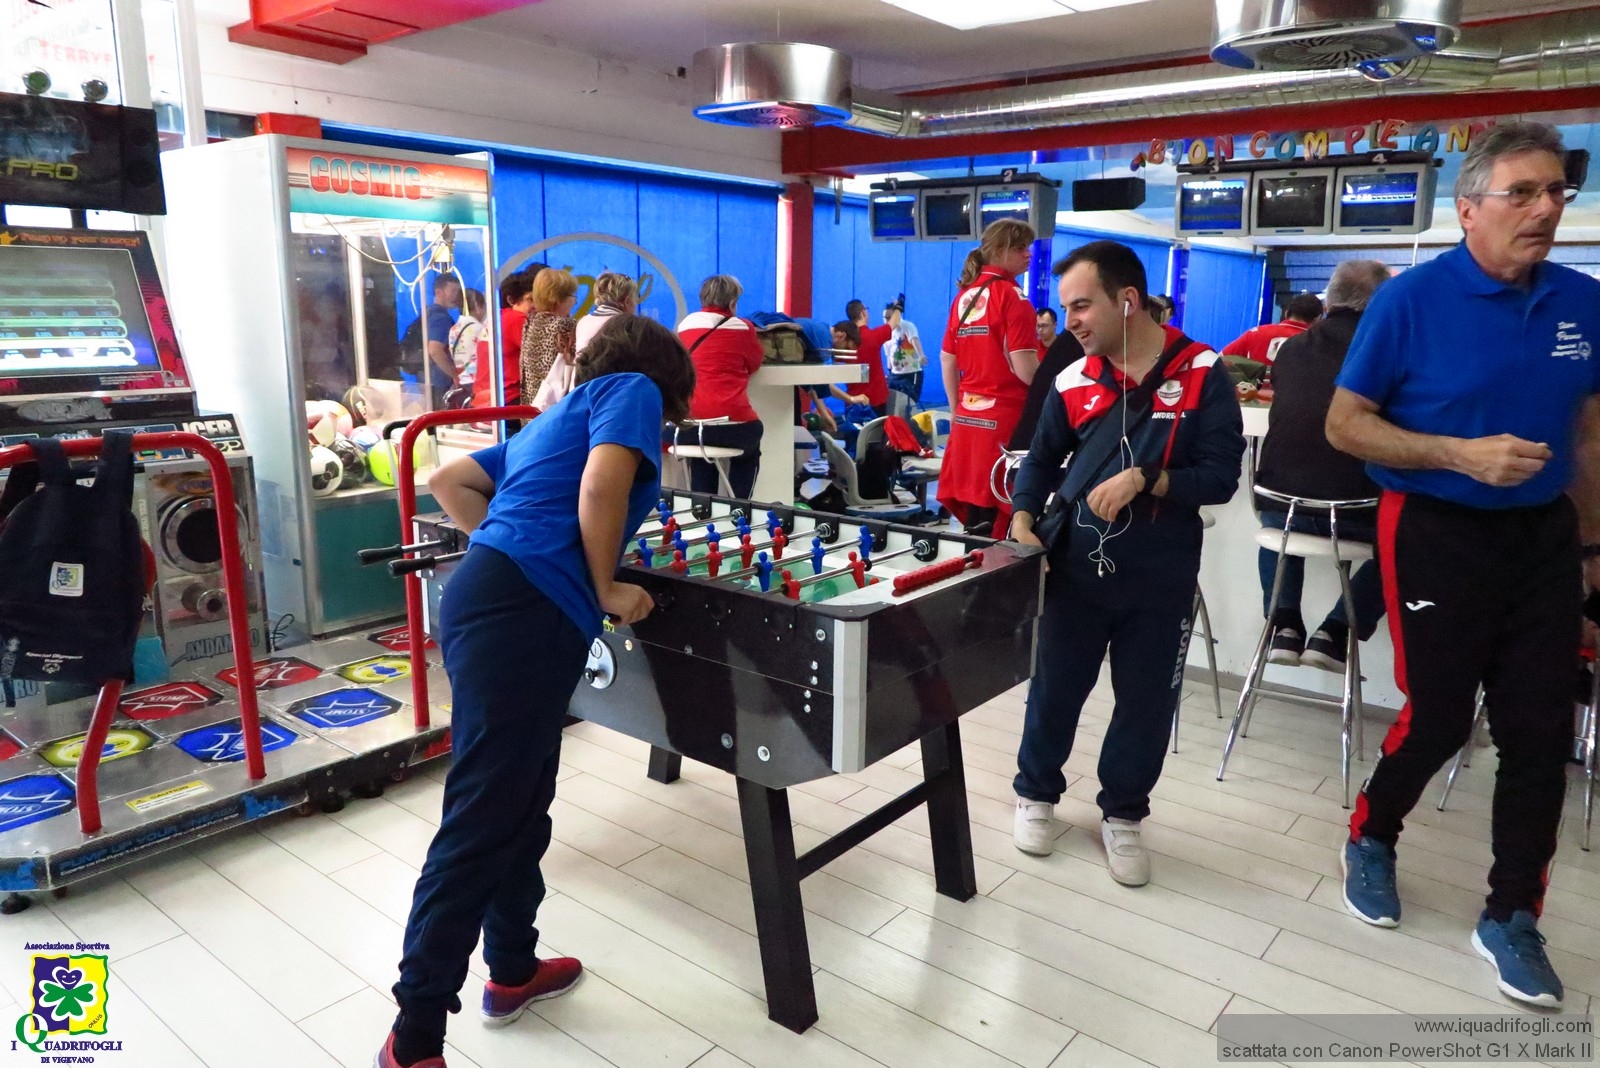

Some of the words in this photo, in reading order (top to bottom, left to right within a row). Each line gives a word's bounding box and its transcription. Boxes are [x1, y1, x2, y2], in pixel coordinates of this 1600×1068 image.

[1371, 153, 1388, 164] 4
[7, 158, 79, 181] PRO
[1003, 169, 1013, 183] 2
[309, 155, 422, 201] COSMIC
[1151, 411, 1180, 420] ANDRE
